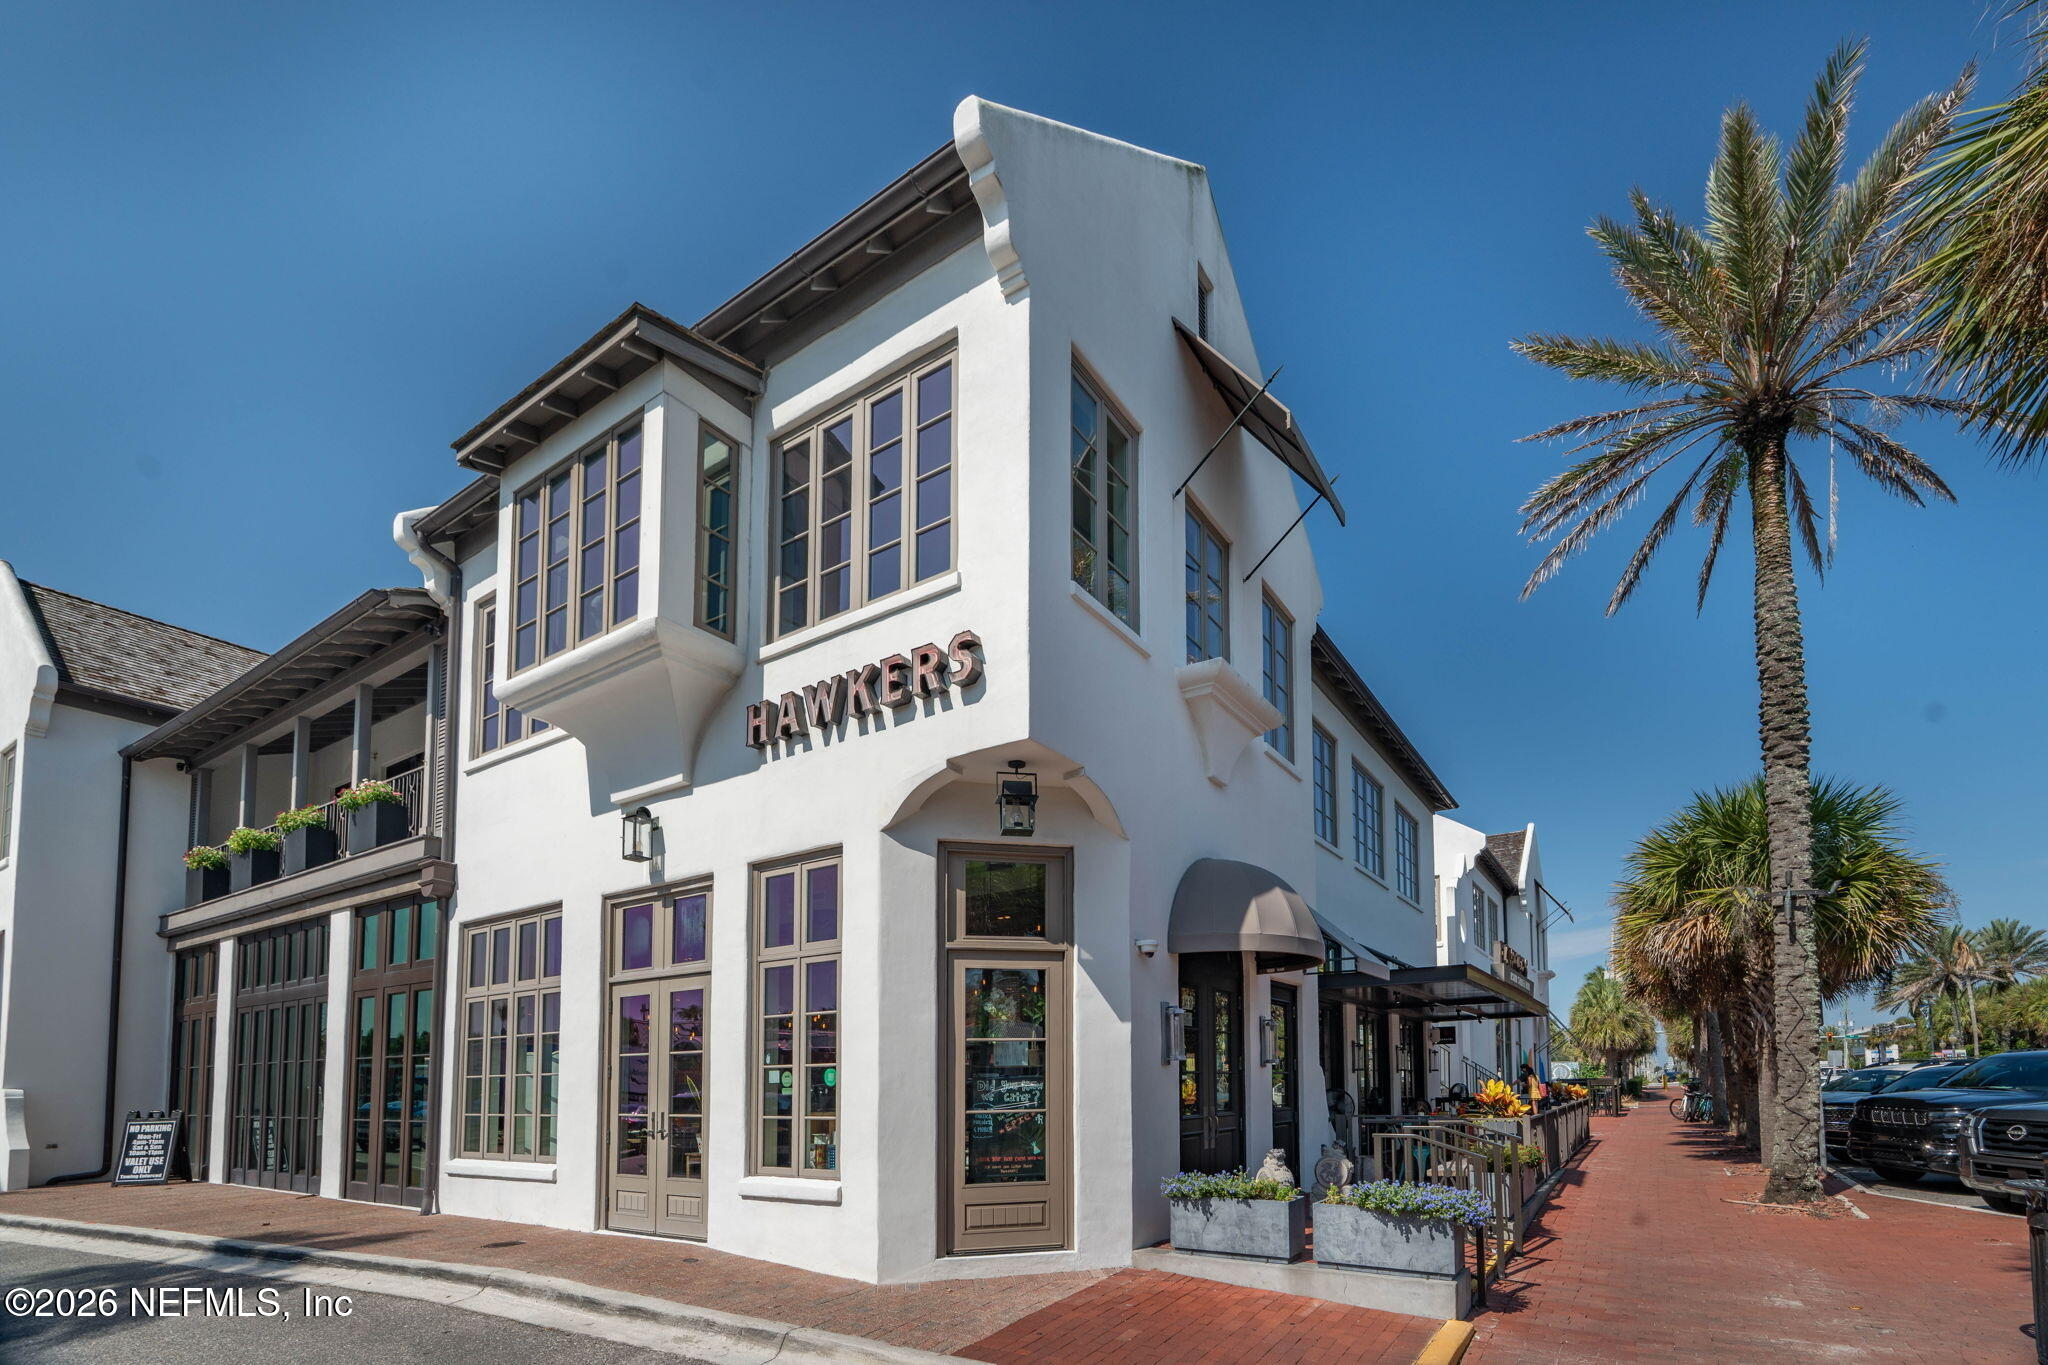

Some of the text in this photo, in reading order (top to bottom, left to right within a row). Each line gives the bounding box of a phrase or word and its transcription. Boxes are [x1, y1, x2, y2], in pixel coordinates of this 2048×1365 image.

[746, 630, 983, 751] HAWKERS
[977, 1080, 995, 1091] Did
[141, 1124, 172, 1132] PARKING
[125, 1156, 164, 1166] VALET USE
[132, 1165, 152, 1174] ONLY
